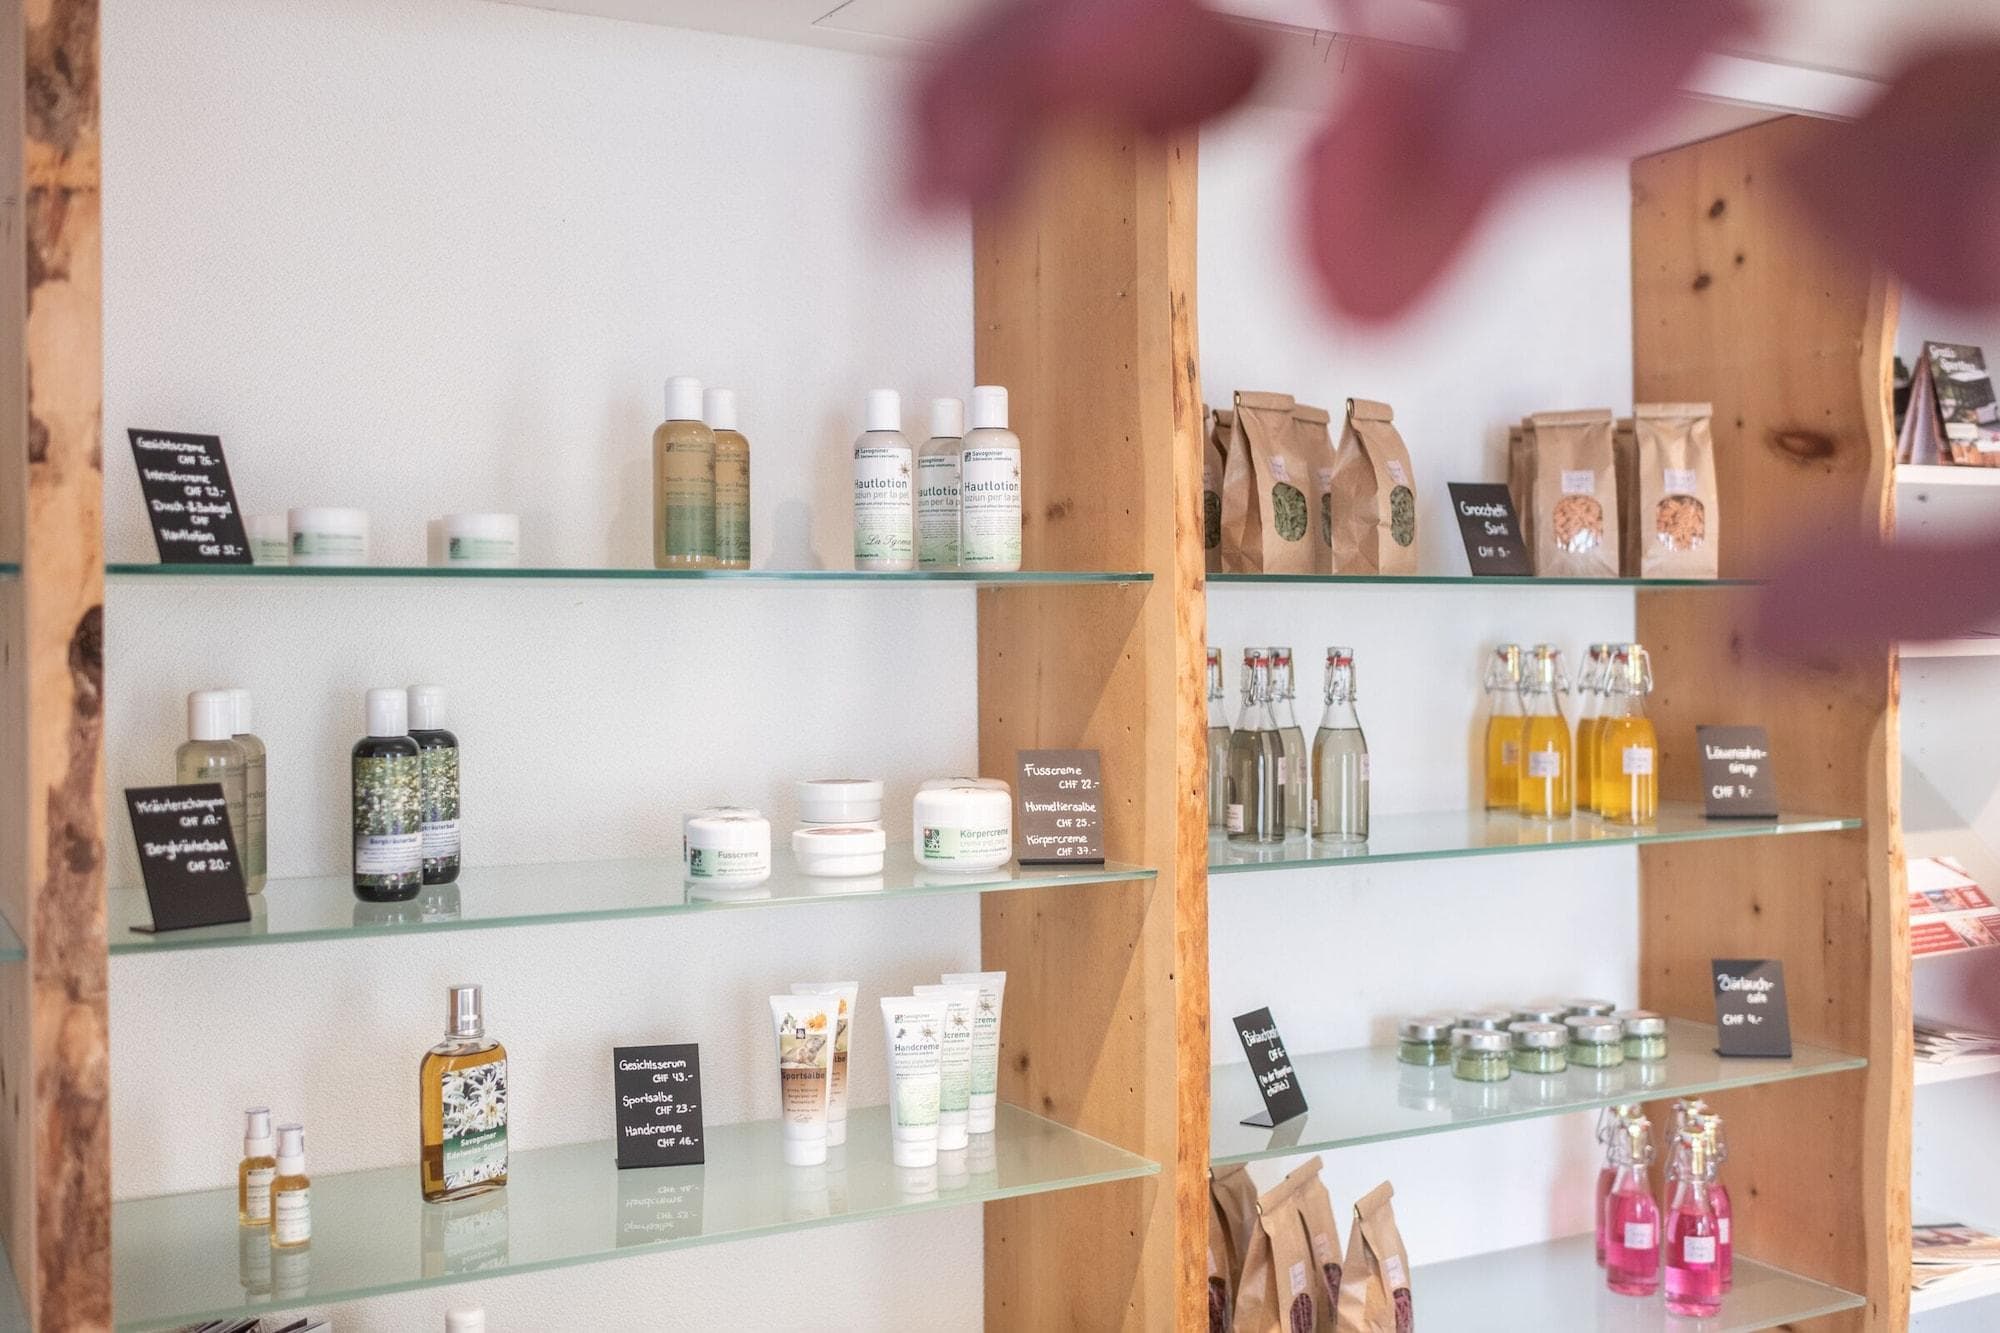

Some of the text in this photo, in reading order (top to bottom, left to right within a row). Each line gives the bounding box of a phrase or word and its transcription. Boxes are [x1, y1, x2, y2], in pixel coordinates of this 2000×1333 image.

[177, 454, 196, 465] CHF
[184, 485, 202, 496] CHF
[919, 486, 961, 497] autlotio
[964, 481, 1018, 491] Hautlotion
[190, 515, 210, 526] CHF
[198, 544, 221, 555] CHF
[1023, 763, 1082, 777] Fusscreme
[1059, 779, 1100, 789] CHF 22.-
[1712, 785, 1734, 799] CHF
[180, 815, 199, 827] CHF
[1056, 818, 1097, 828] CHF 25.-
[1026, 835, 1088, 847] Körpercreme
[1056, 847, 1073, 857] CHF
[186, 861, 207, 873] CHF
[1722, 1013, 1744, 1026] CHF
[894, 1043, 940, 1052] Handcreme
[619, 1058, 687, 1071] Gesichtsserum
[652, 1072, 694, 1083] CHF 43.-
[622, 1091, 673, 1109] Sportsalbe
[655, 1104, 697, 1116] CHF 23.-
[625, 1122, 683, 1136] Handcreme
[460, 1131, 497, 1147] Savogniner
[657, 1138, 675, 1148] CHF
